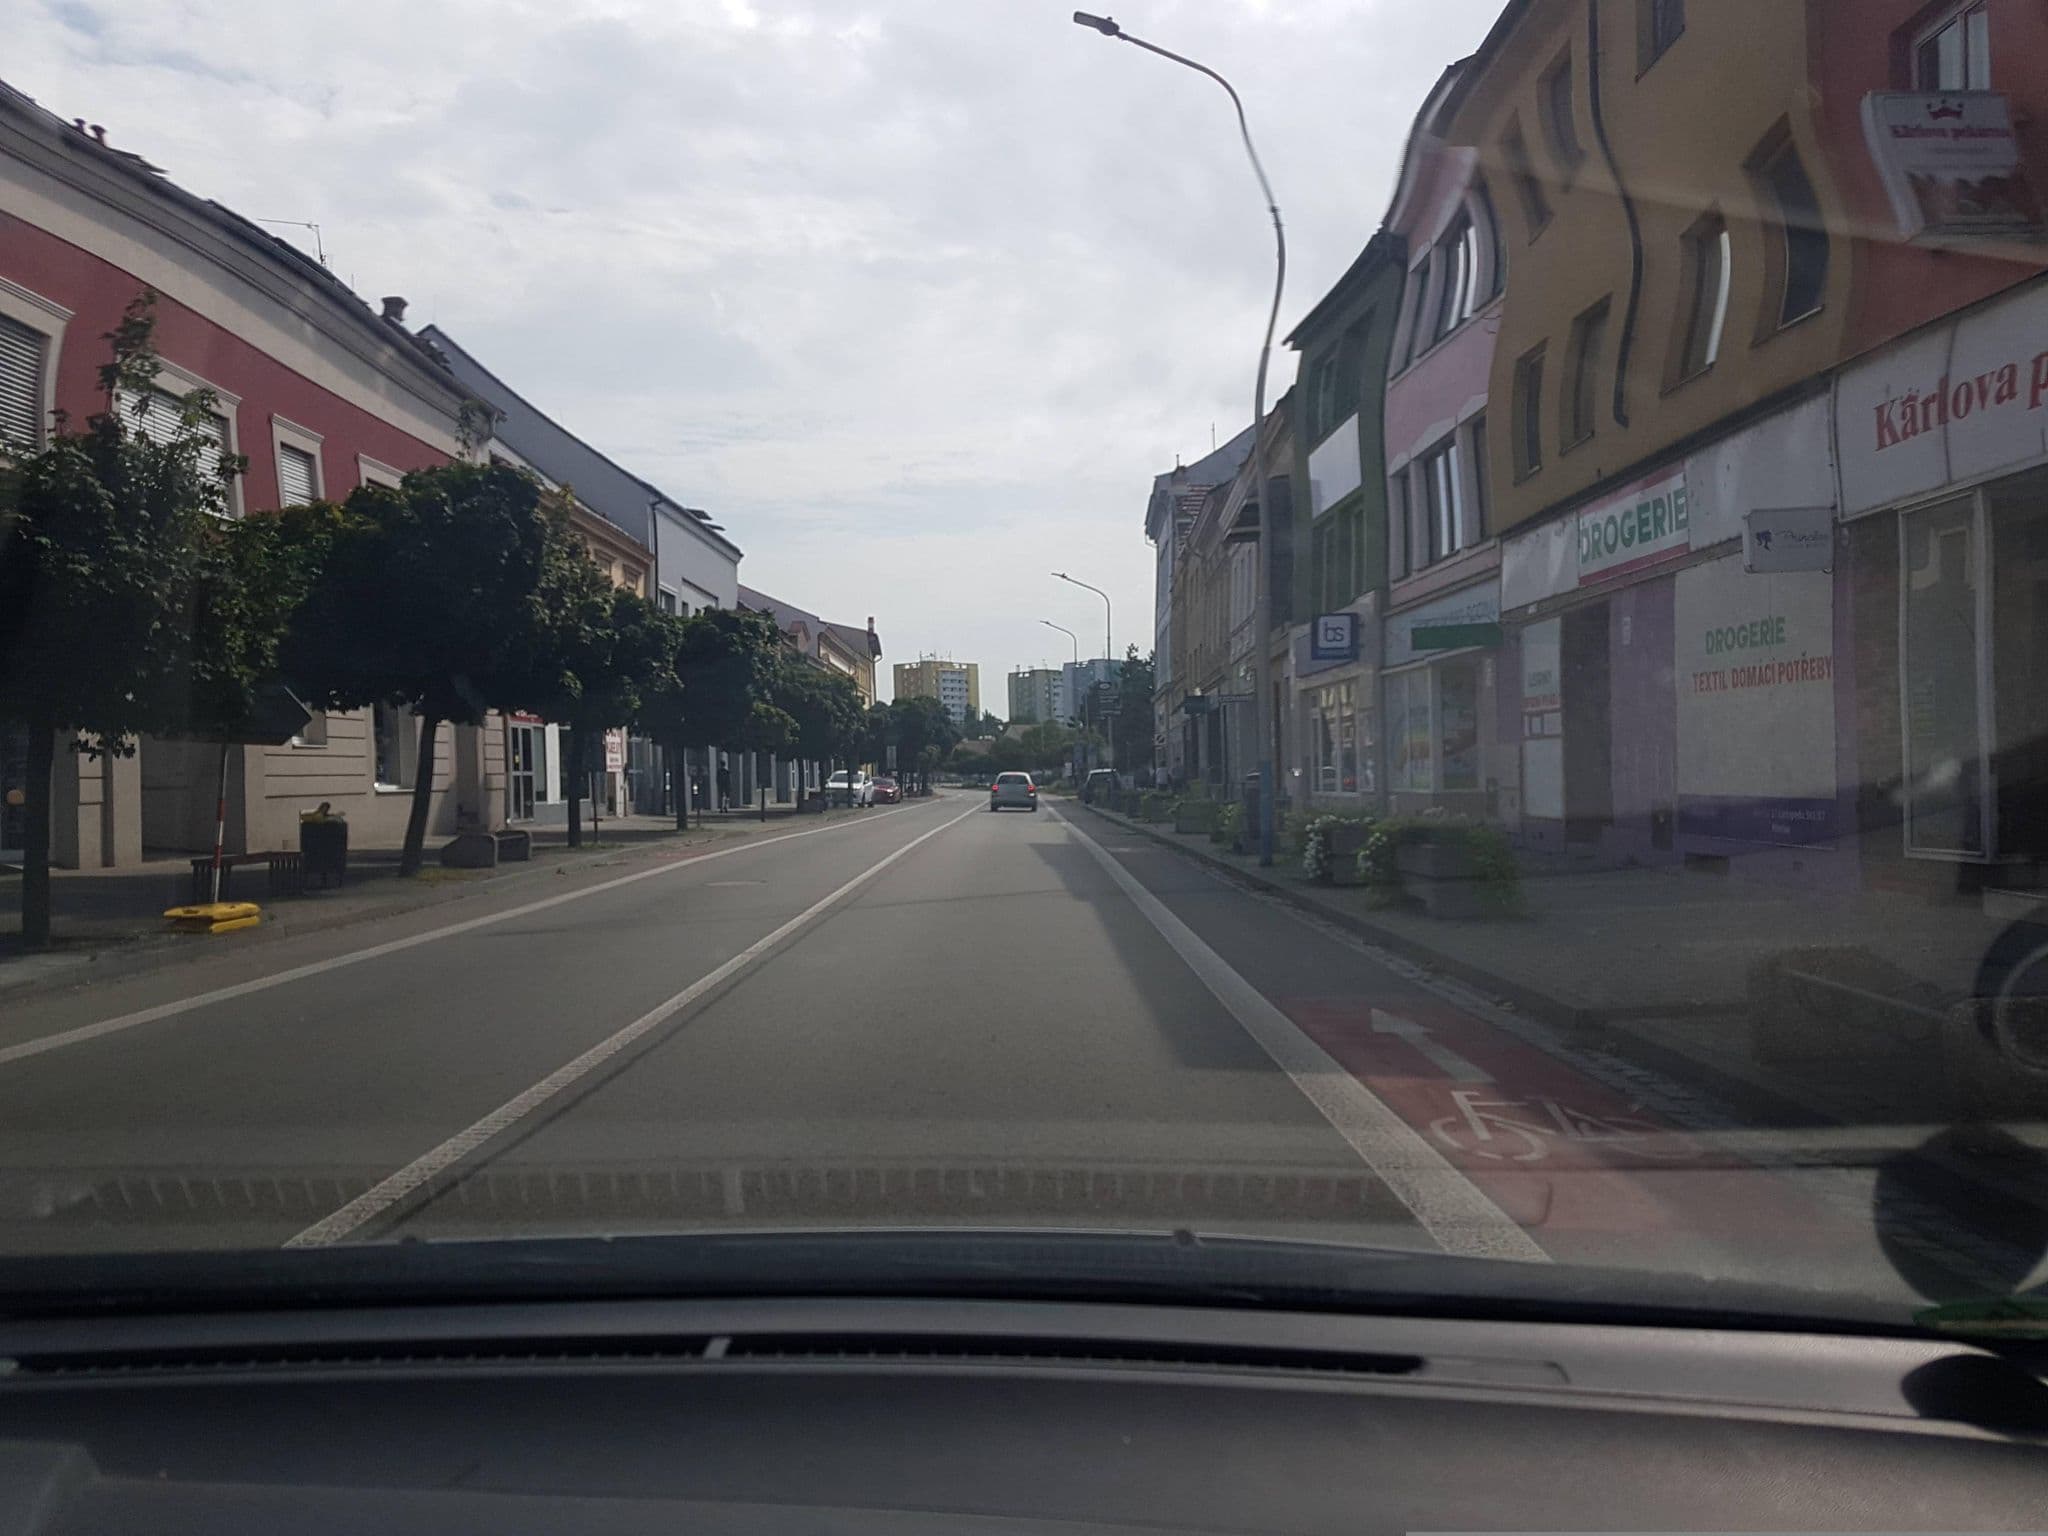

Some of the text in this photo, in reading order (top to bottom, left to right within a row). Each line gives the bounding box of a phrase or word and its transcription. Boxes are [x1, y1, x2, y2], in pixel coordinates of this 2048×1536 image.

[1580, 487, 1689, 564] DROGERIE
[1705, 616, 1787, 655] DROGERIE
[1693, 670, 1729, 693] TEXTIL
[1778, 651, 1833, 684] POTŘEBY
